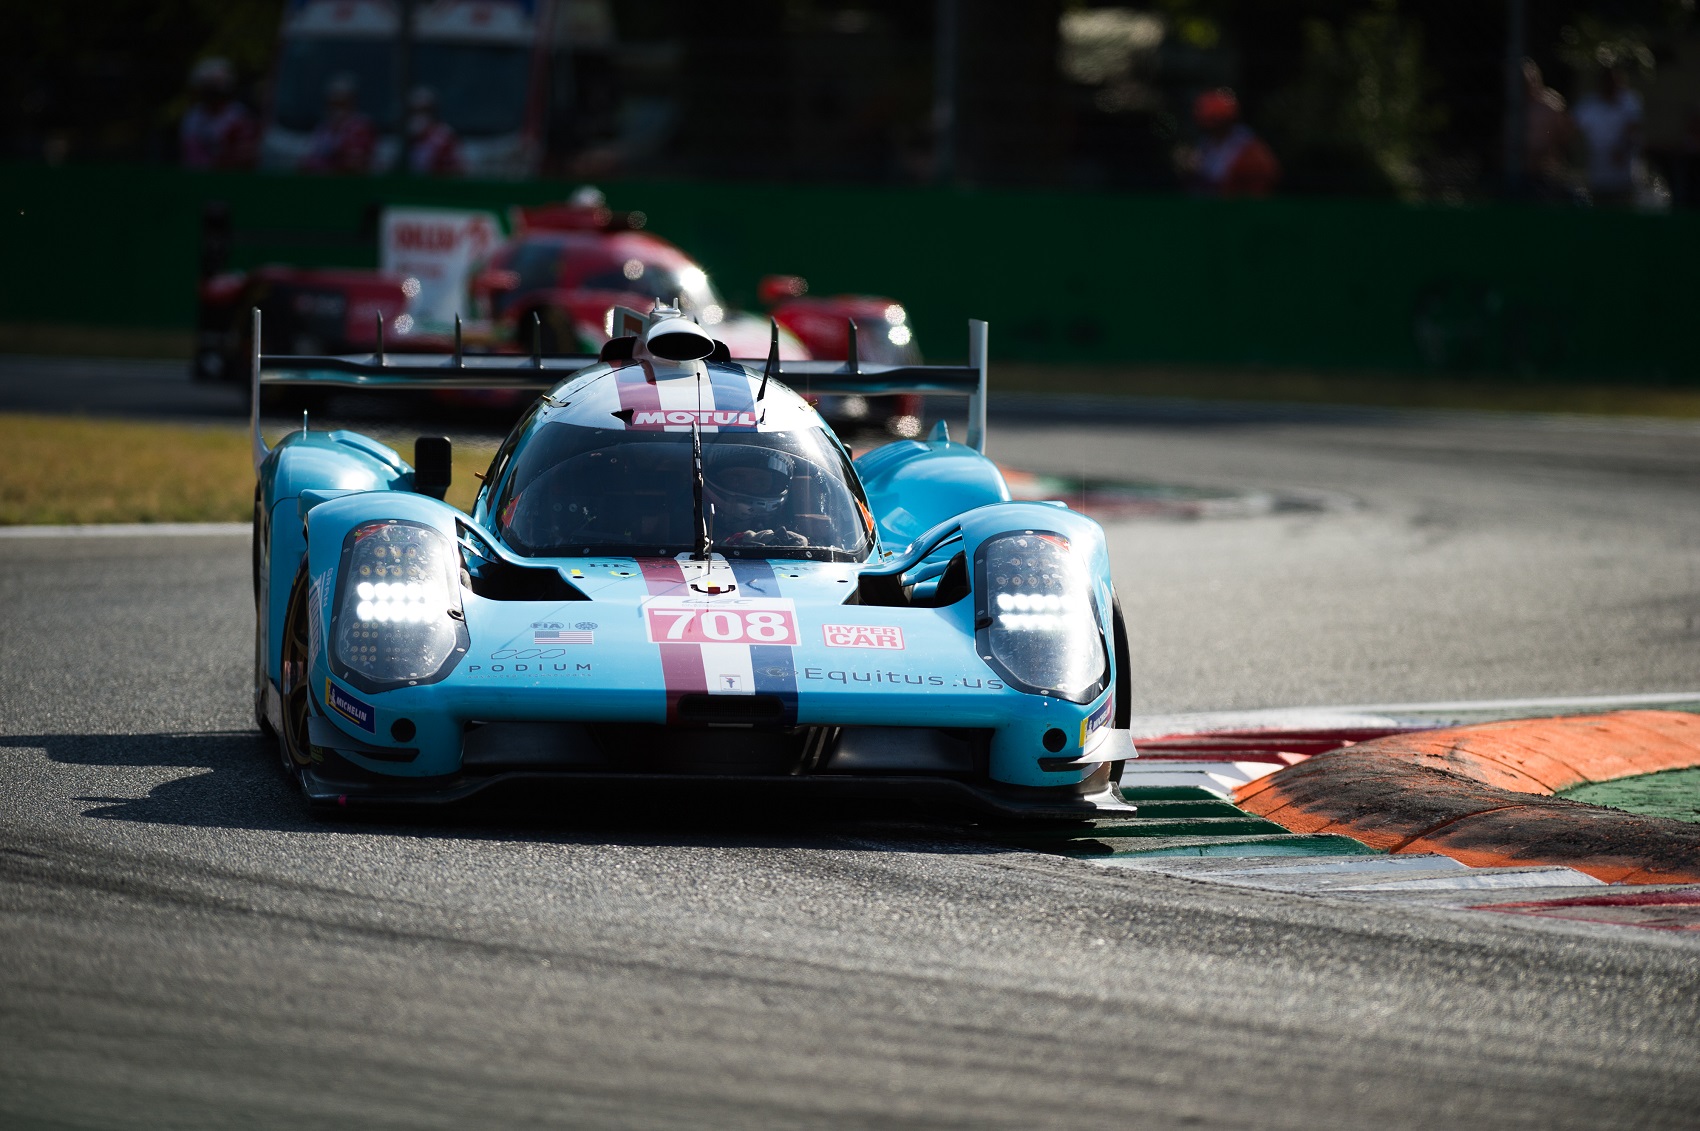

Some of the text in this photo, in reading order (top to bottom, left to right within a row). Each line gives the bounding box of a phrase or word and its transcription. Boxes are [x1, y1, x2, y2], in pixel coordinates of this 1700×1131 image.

[634, 411, 757, 425] MOTUL
[653, 610, 789, 642] 708
[828, 626, 896, 635] HYPER
[830, 634, 898, 647] CAR
[469, 664, 592, 672] PODIUM
[804, 667, 1004, 690] Equitus.us
[336, 696, 367, 722] MICHELIN
